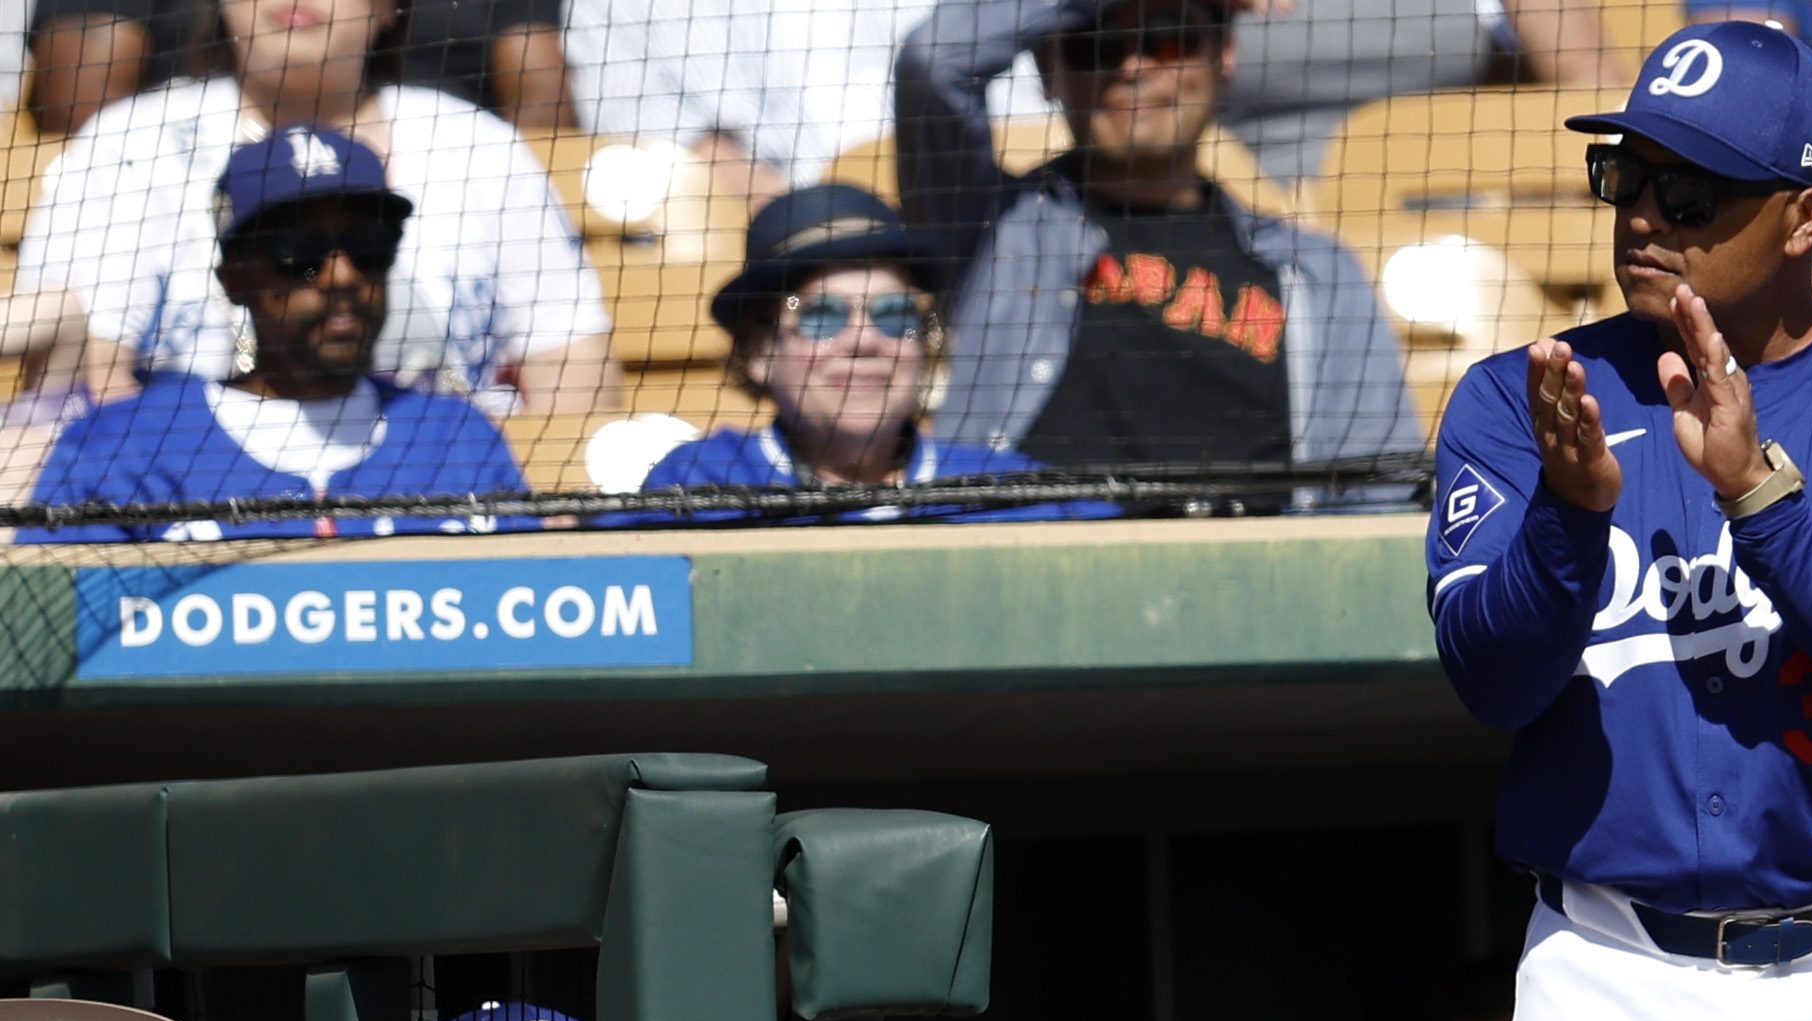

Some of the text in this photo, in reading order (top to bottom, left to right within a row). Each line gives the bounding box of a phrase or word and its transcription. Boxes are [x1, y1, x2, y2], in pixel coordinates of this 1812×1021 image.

[1649, 39, 1723, 98] D
[286, 126, 340, 177] LA
[1085, 253, 1284, 363] APAN
[1448, 484, 1478, 523] G
[119, 585, 658, 648] DODGERS.COM
[1592, 520, 1784, 679] Dodg
